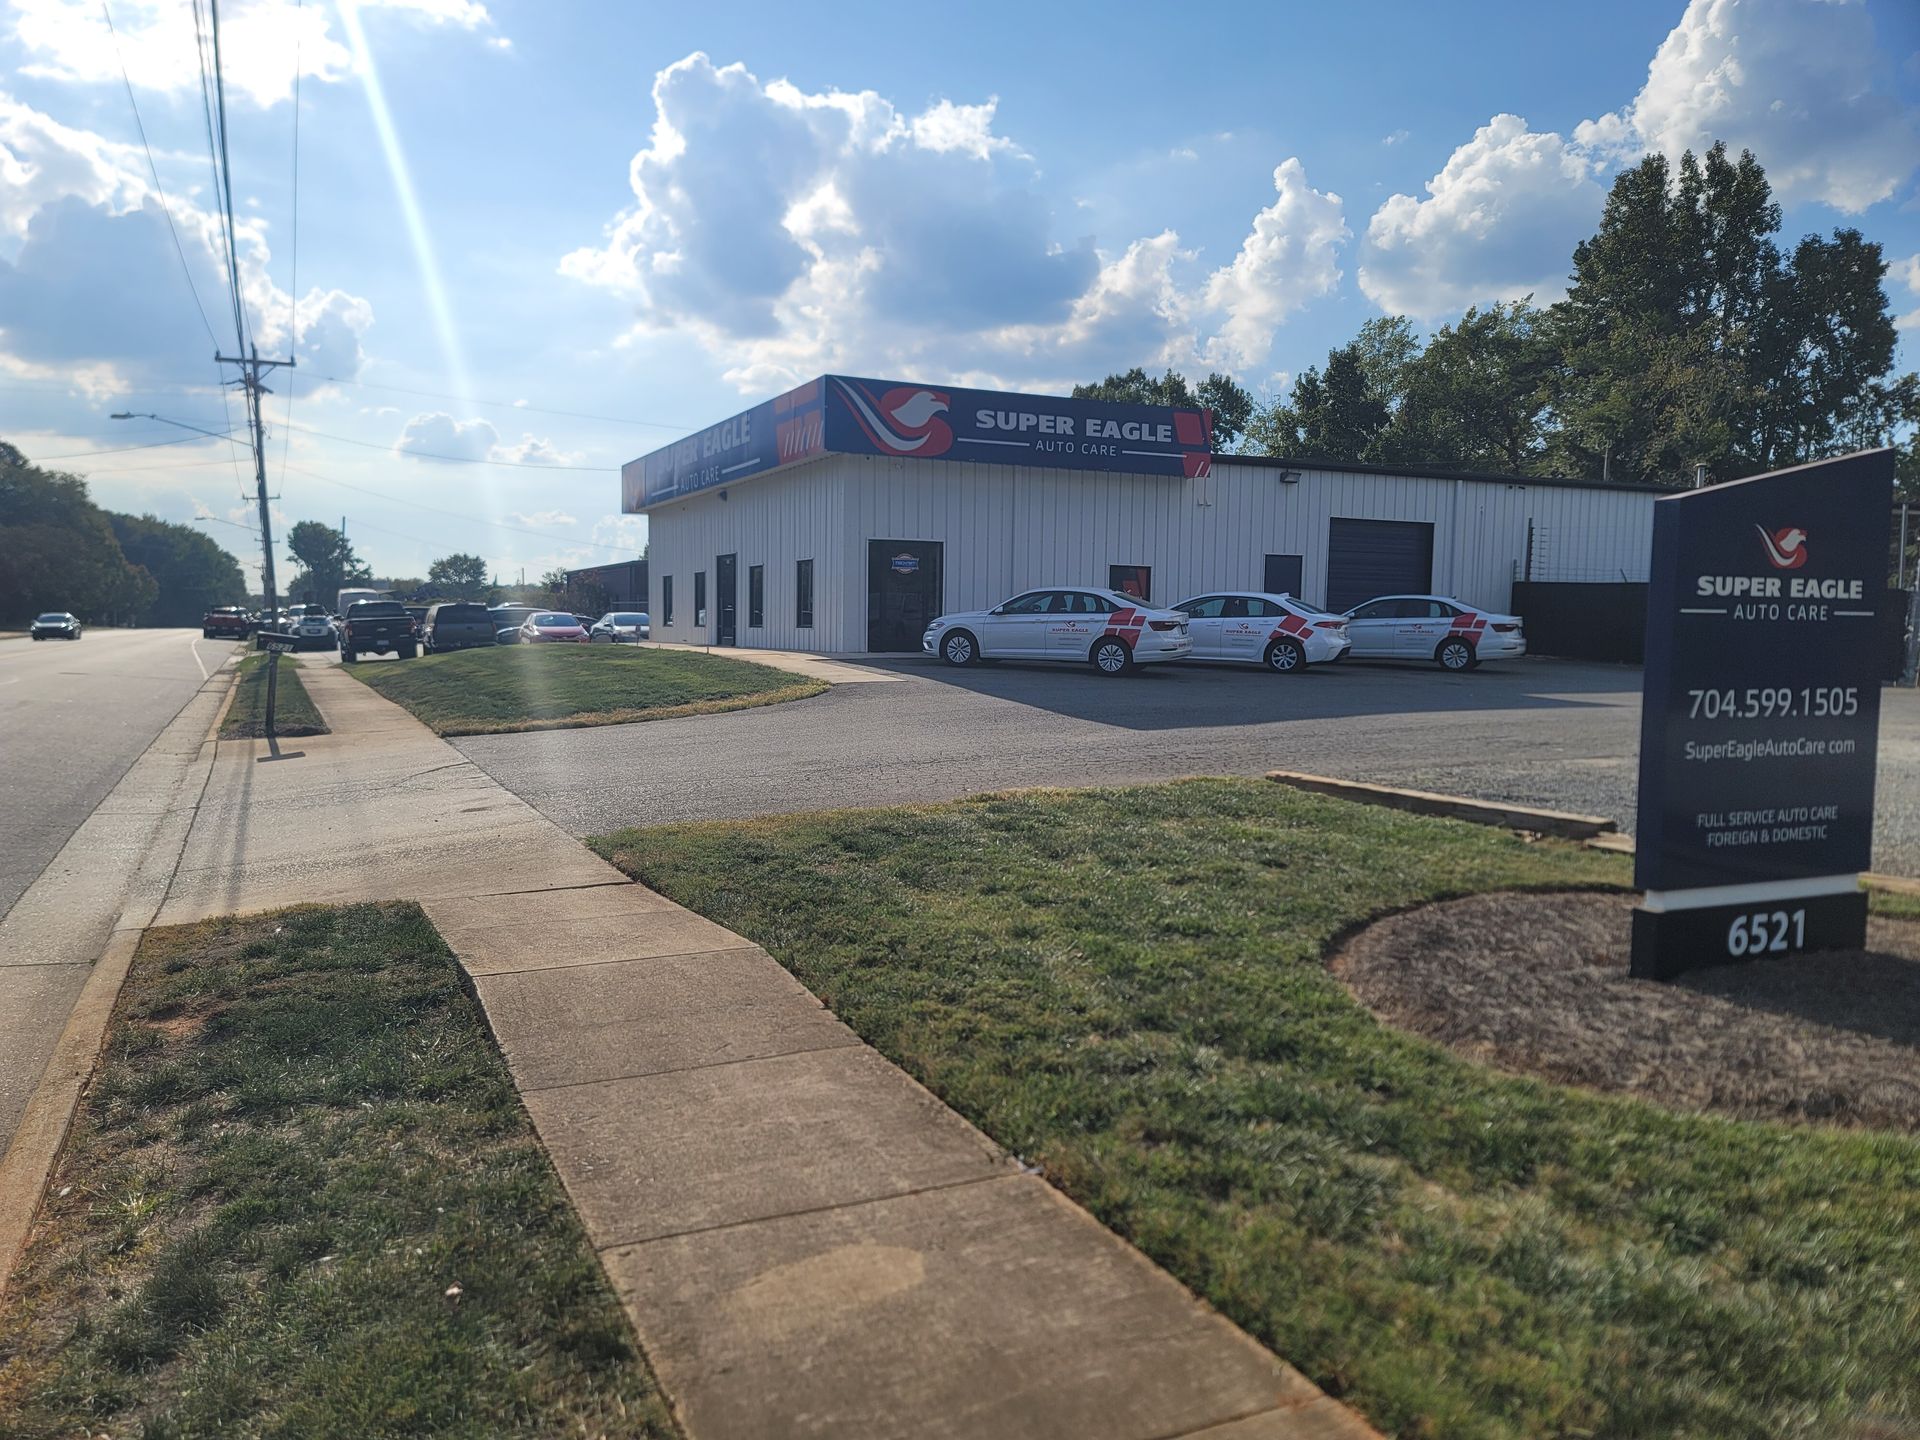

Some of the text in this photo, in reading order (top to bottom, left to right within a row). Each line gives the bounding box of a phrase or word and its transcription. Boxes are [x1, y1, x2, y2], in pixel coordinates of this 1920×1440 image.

[975, 409, 1172, 443] SUPER EAGLE
[656, 411, 751, 474] UPER EAGLE
[1035, 439, 1117, 457] AUTO CARE
[680, 465, 720, 492] AUTO CARE
[1696, 575, 1863, 599] SUPER EAGLE
[1733, 603, 1828, 621] AUTO CARE
[1688, 687, 1858, 719] 704.599.1505
[1685, 737, 1856, 763] SuperEagleAutoCarecom
[1697, 804, 1839, 828] FULL SERVICE AUTO CARE
[1708, 825, 1828, 848] FOREIGN & DOMESTIC
[1728, 908, 1806, 957] 6521
